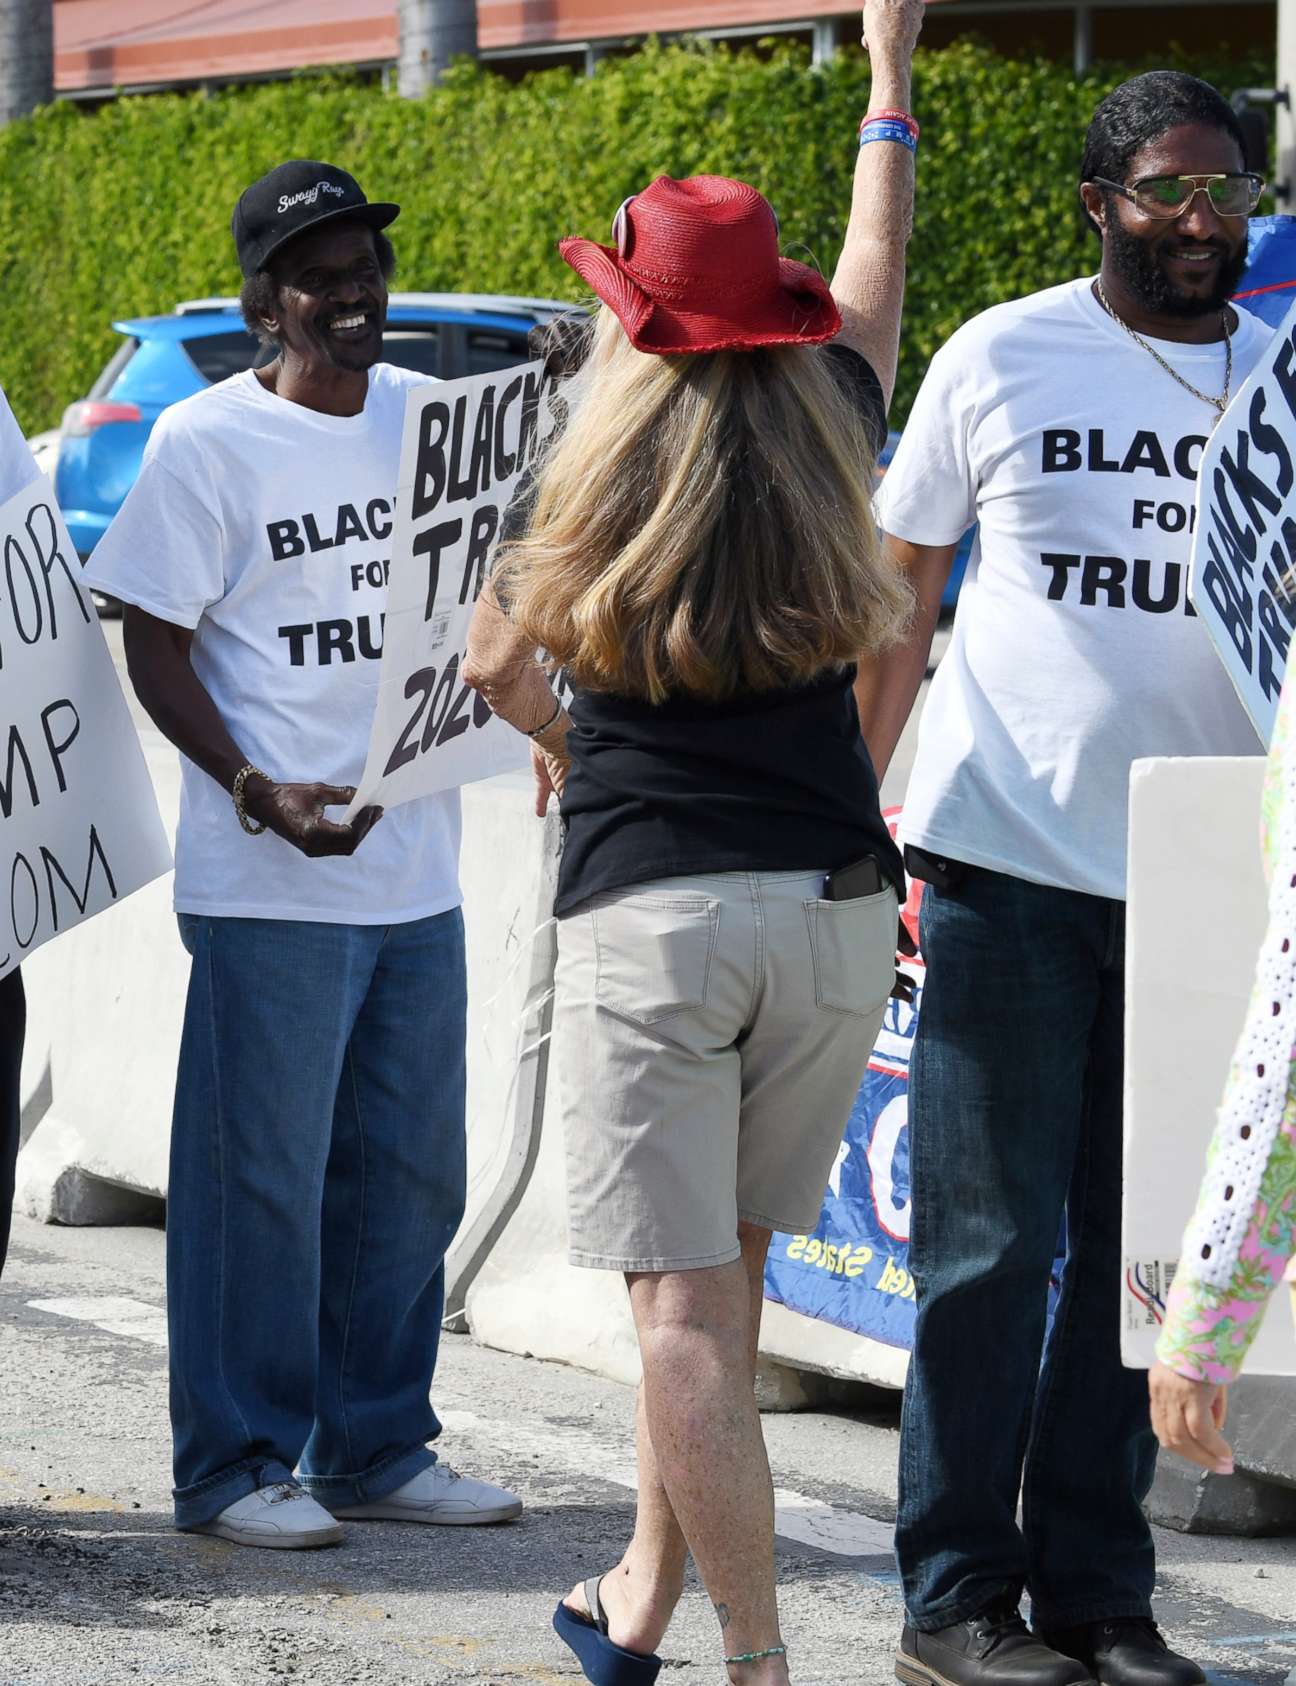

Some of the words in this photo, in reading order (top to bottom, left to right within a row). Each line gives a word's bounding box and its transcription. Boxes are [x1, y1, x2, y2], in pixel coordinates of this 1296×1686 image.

[1041, 428, 1210, 481] BLAC
[266, 496, 397, 561] BLAC
[1132, 499, 1197, 534] FO
[1202, 386, 1294, 675] BLACKS
[1040, 552, 1198, 617] TRU
[278, 612, 386, 666] TRU
